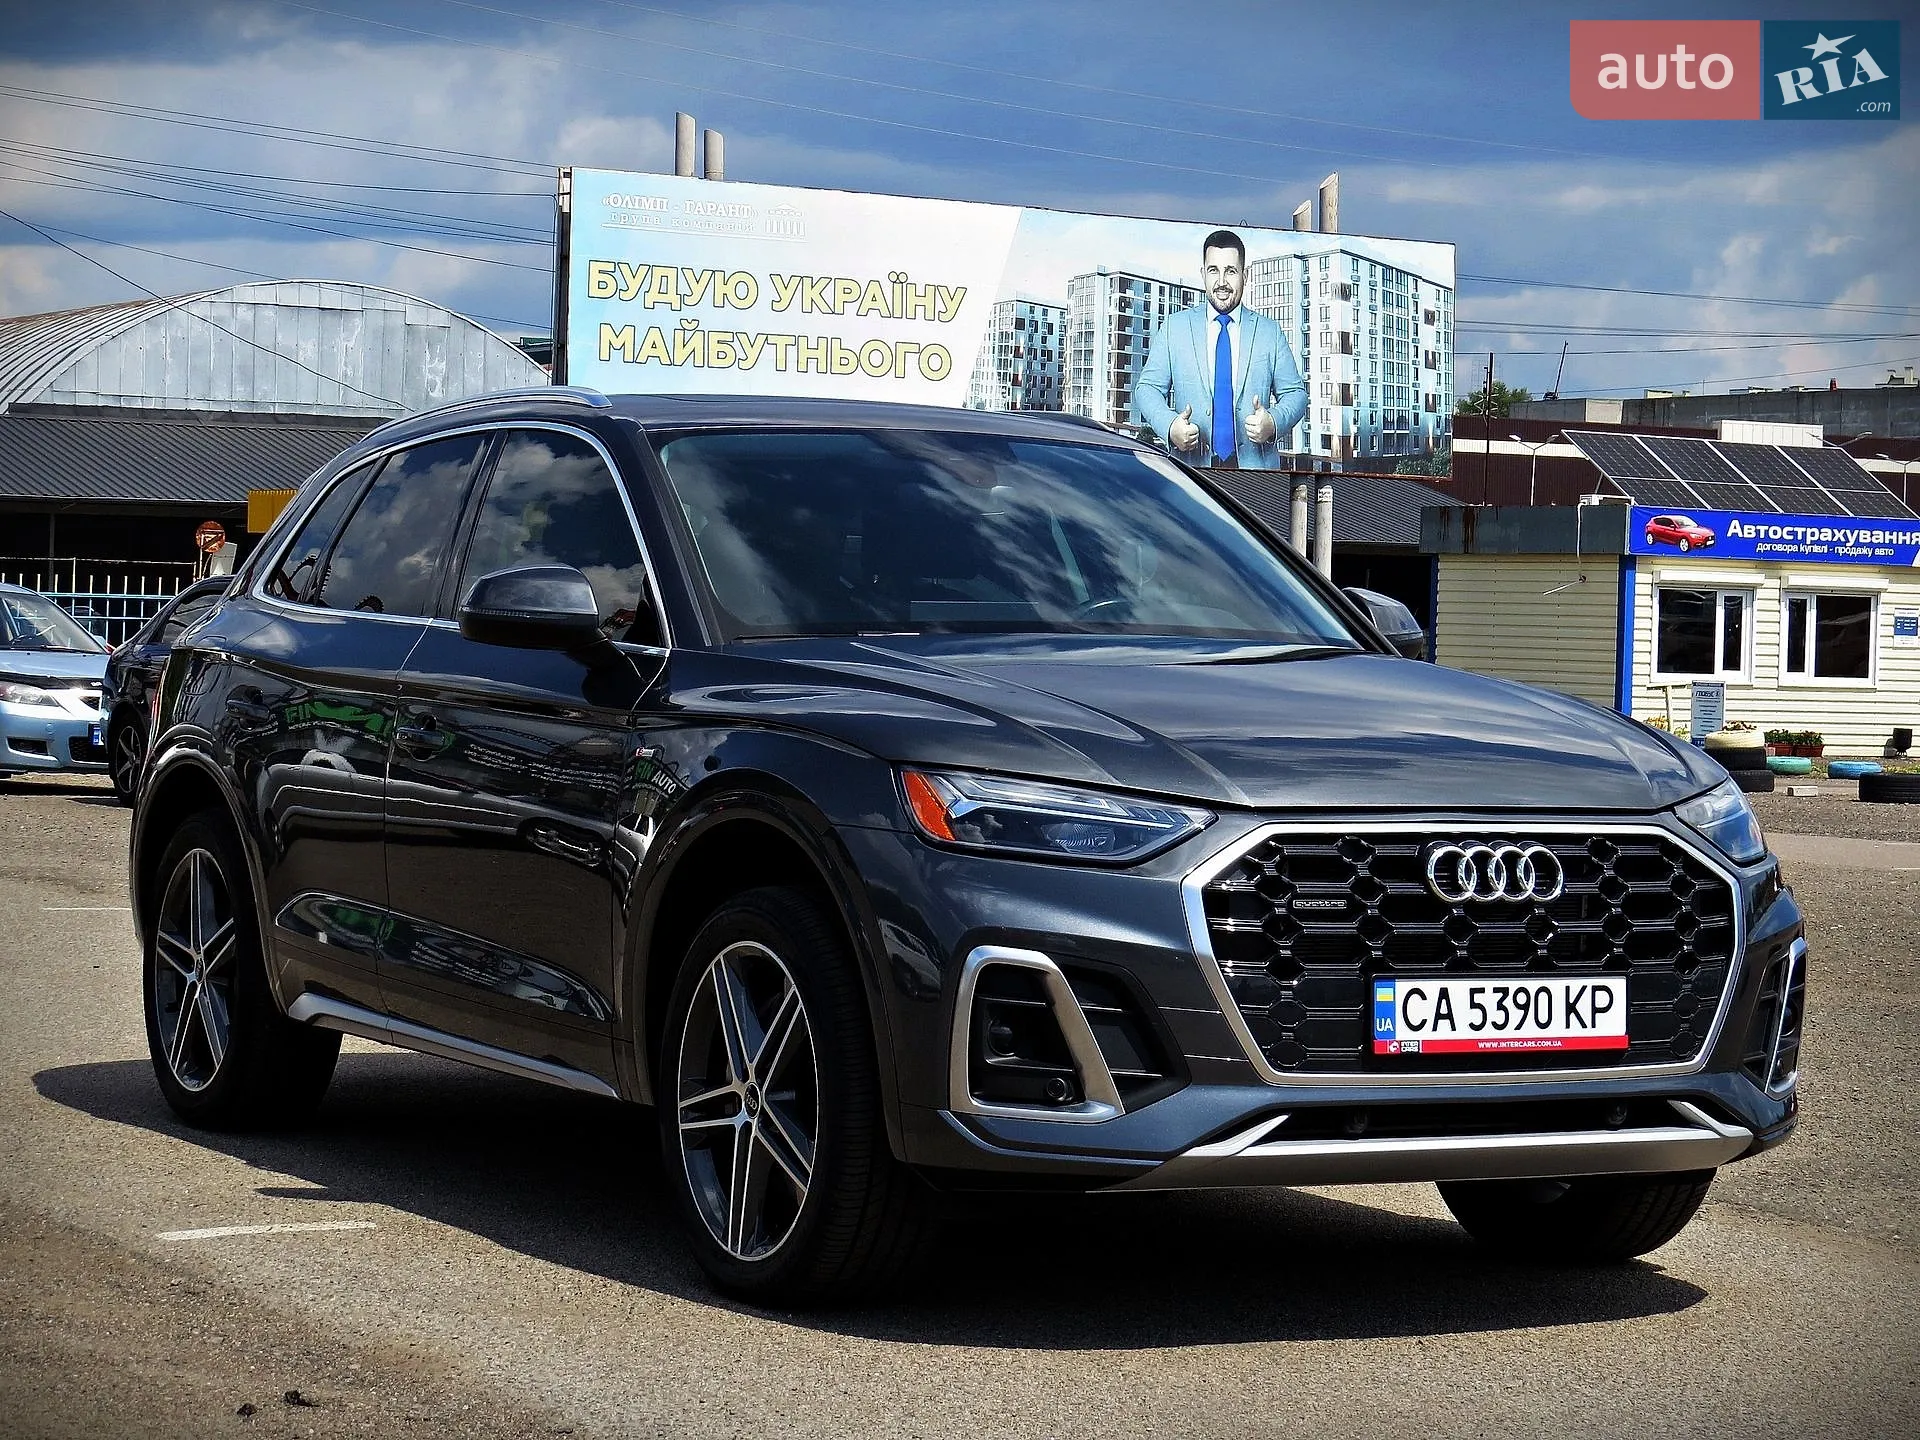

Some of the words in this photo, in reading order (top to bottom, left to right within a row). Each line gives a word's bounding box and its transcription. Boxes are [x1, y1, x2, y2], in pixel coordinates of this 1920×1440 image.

[587, 260, 759, 311] БУДУЮ
[769, 271, 967, 323] УКРАЇНУ
[598, 319, 953, 381] МАЙБУТНЬОГО
[1726, 519, 1920, 546] Автострахування
[1756, 543, 1798, 553] договора
[1834, 546, 1873, 557] продажу
[1376, 1018, 1394, 1032] UA
[1401, 987, 1457, 1032] CA
[1468, 986, 1553, 1031] 5390
[1565, 985, 1614, 1029] KP
